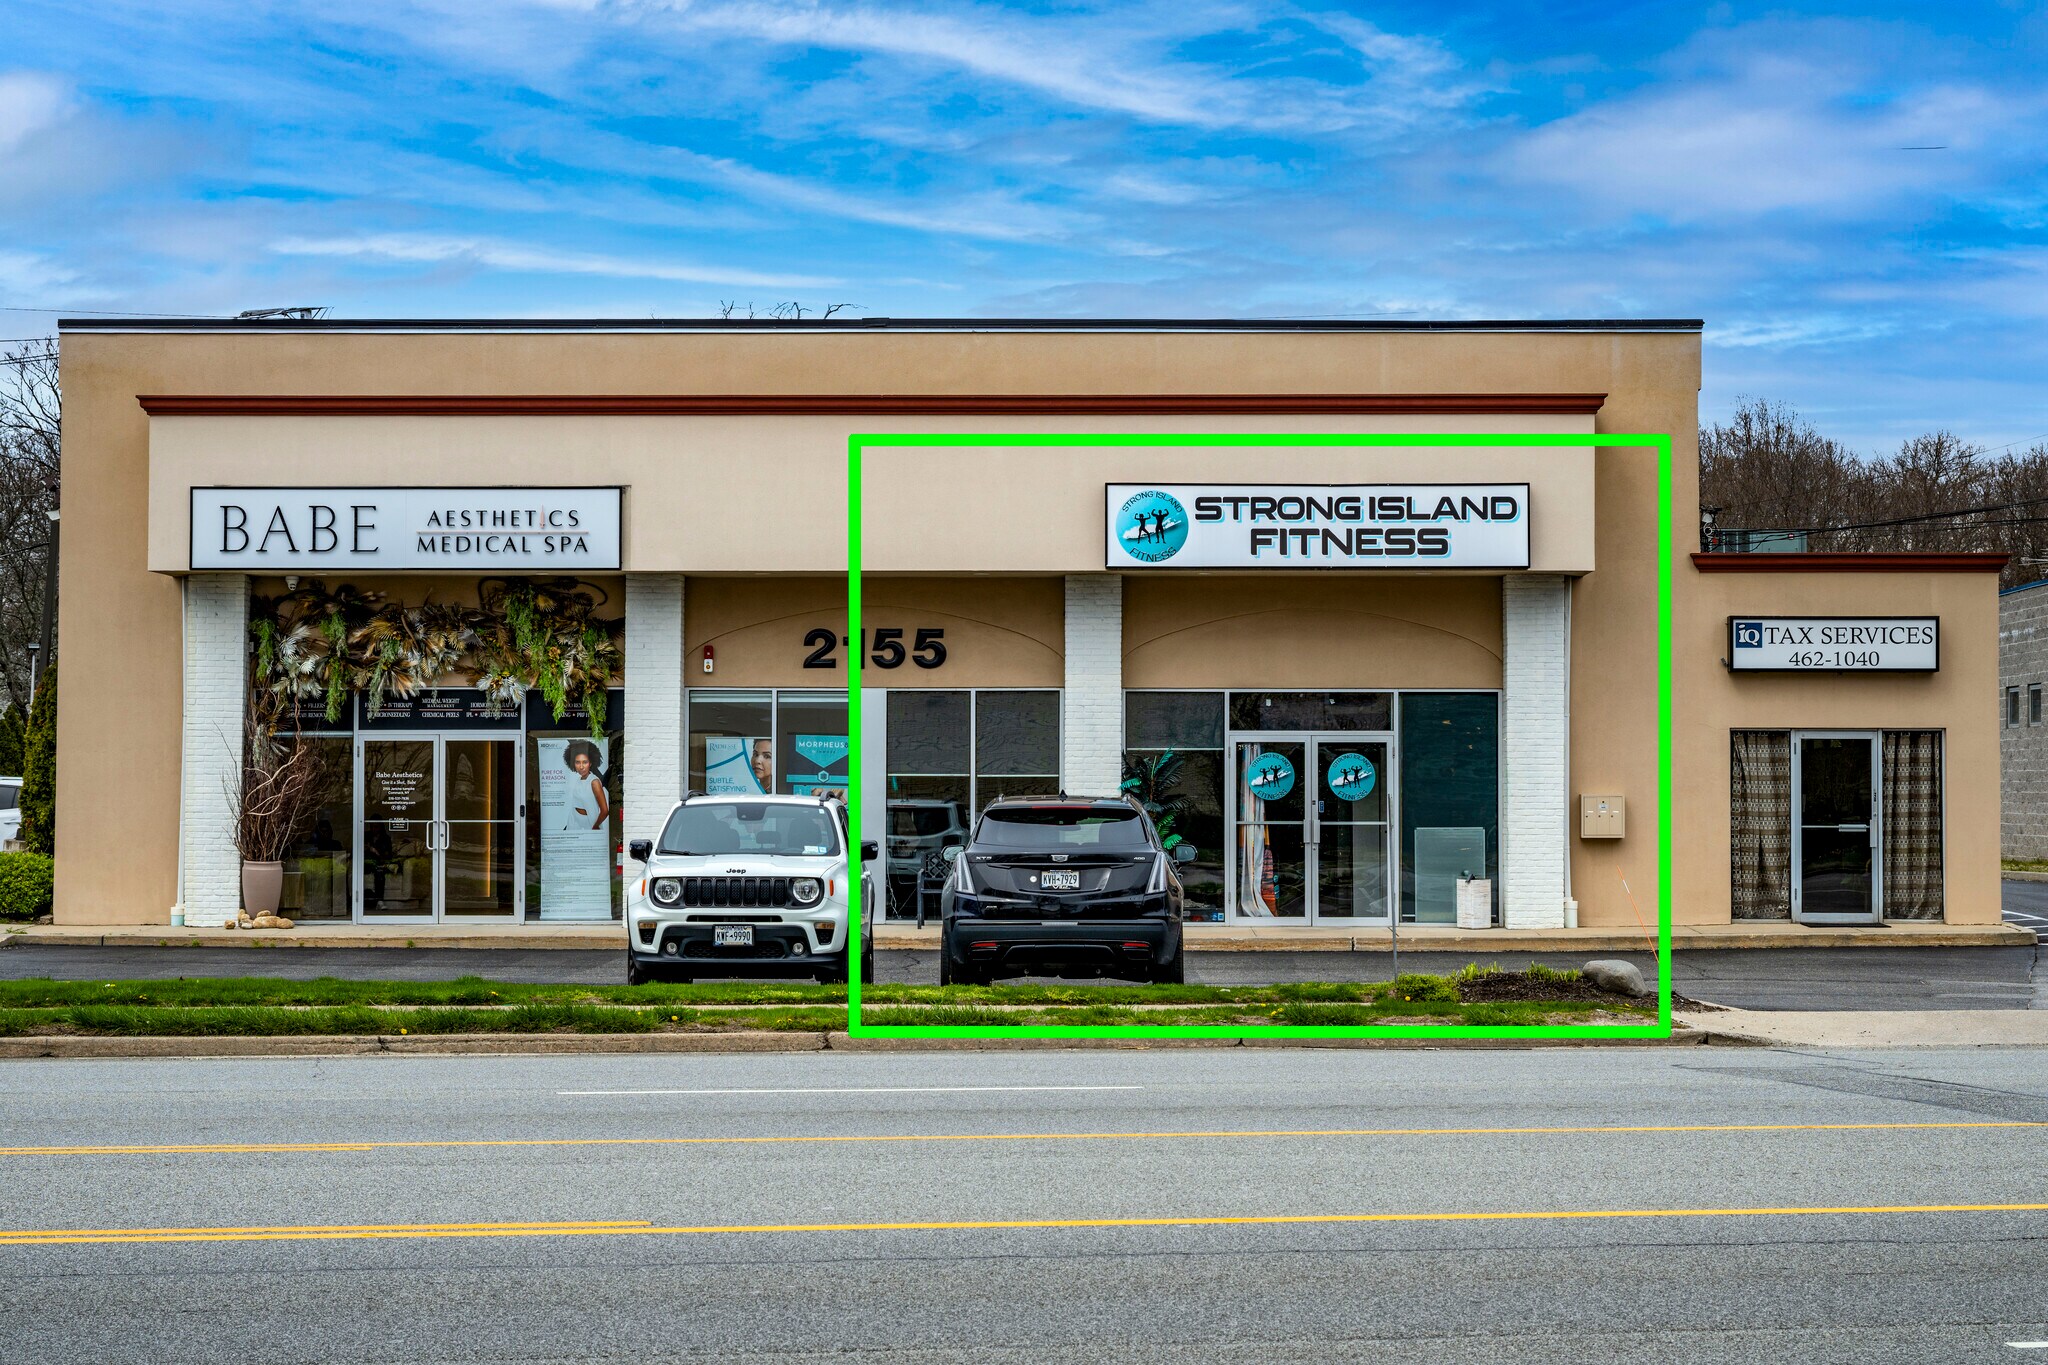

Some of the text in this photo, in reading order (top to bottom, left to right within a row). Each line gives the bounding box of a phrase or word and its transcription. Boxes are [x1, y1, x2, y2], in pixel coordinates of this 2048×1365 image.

[1122, 491, 1183, 513] STRONG ISLAND
[1194, 496, 1520, 523] STRONG ISLAND
[219, 505, 379, 552] BABE
[416, 536, 588, 553] MEDICAL SPA
[1250, 528, 1451, 558] FITNESS
[1129, 546, 1177, 562] FITNESS
[1765, 627, 1934, 645] TAX SERVICES
[1788, 651, 1880, 667] 462-1040
